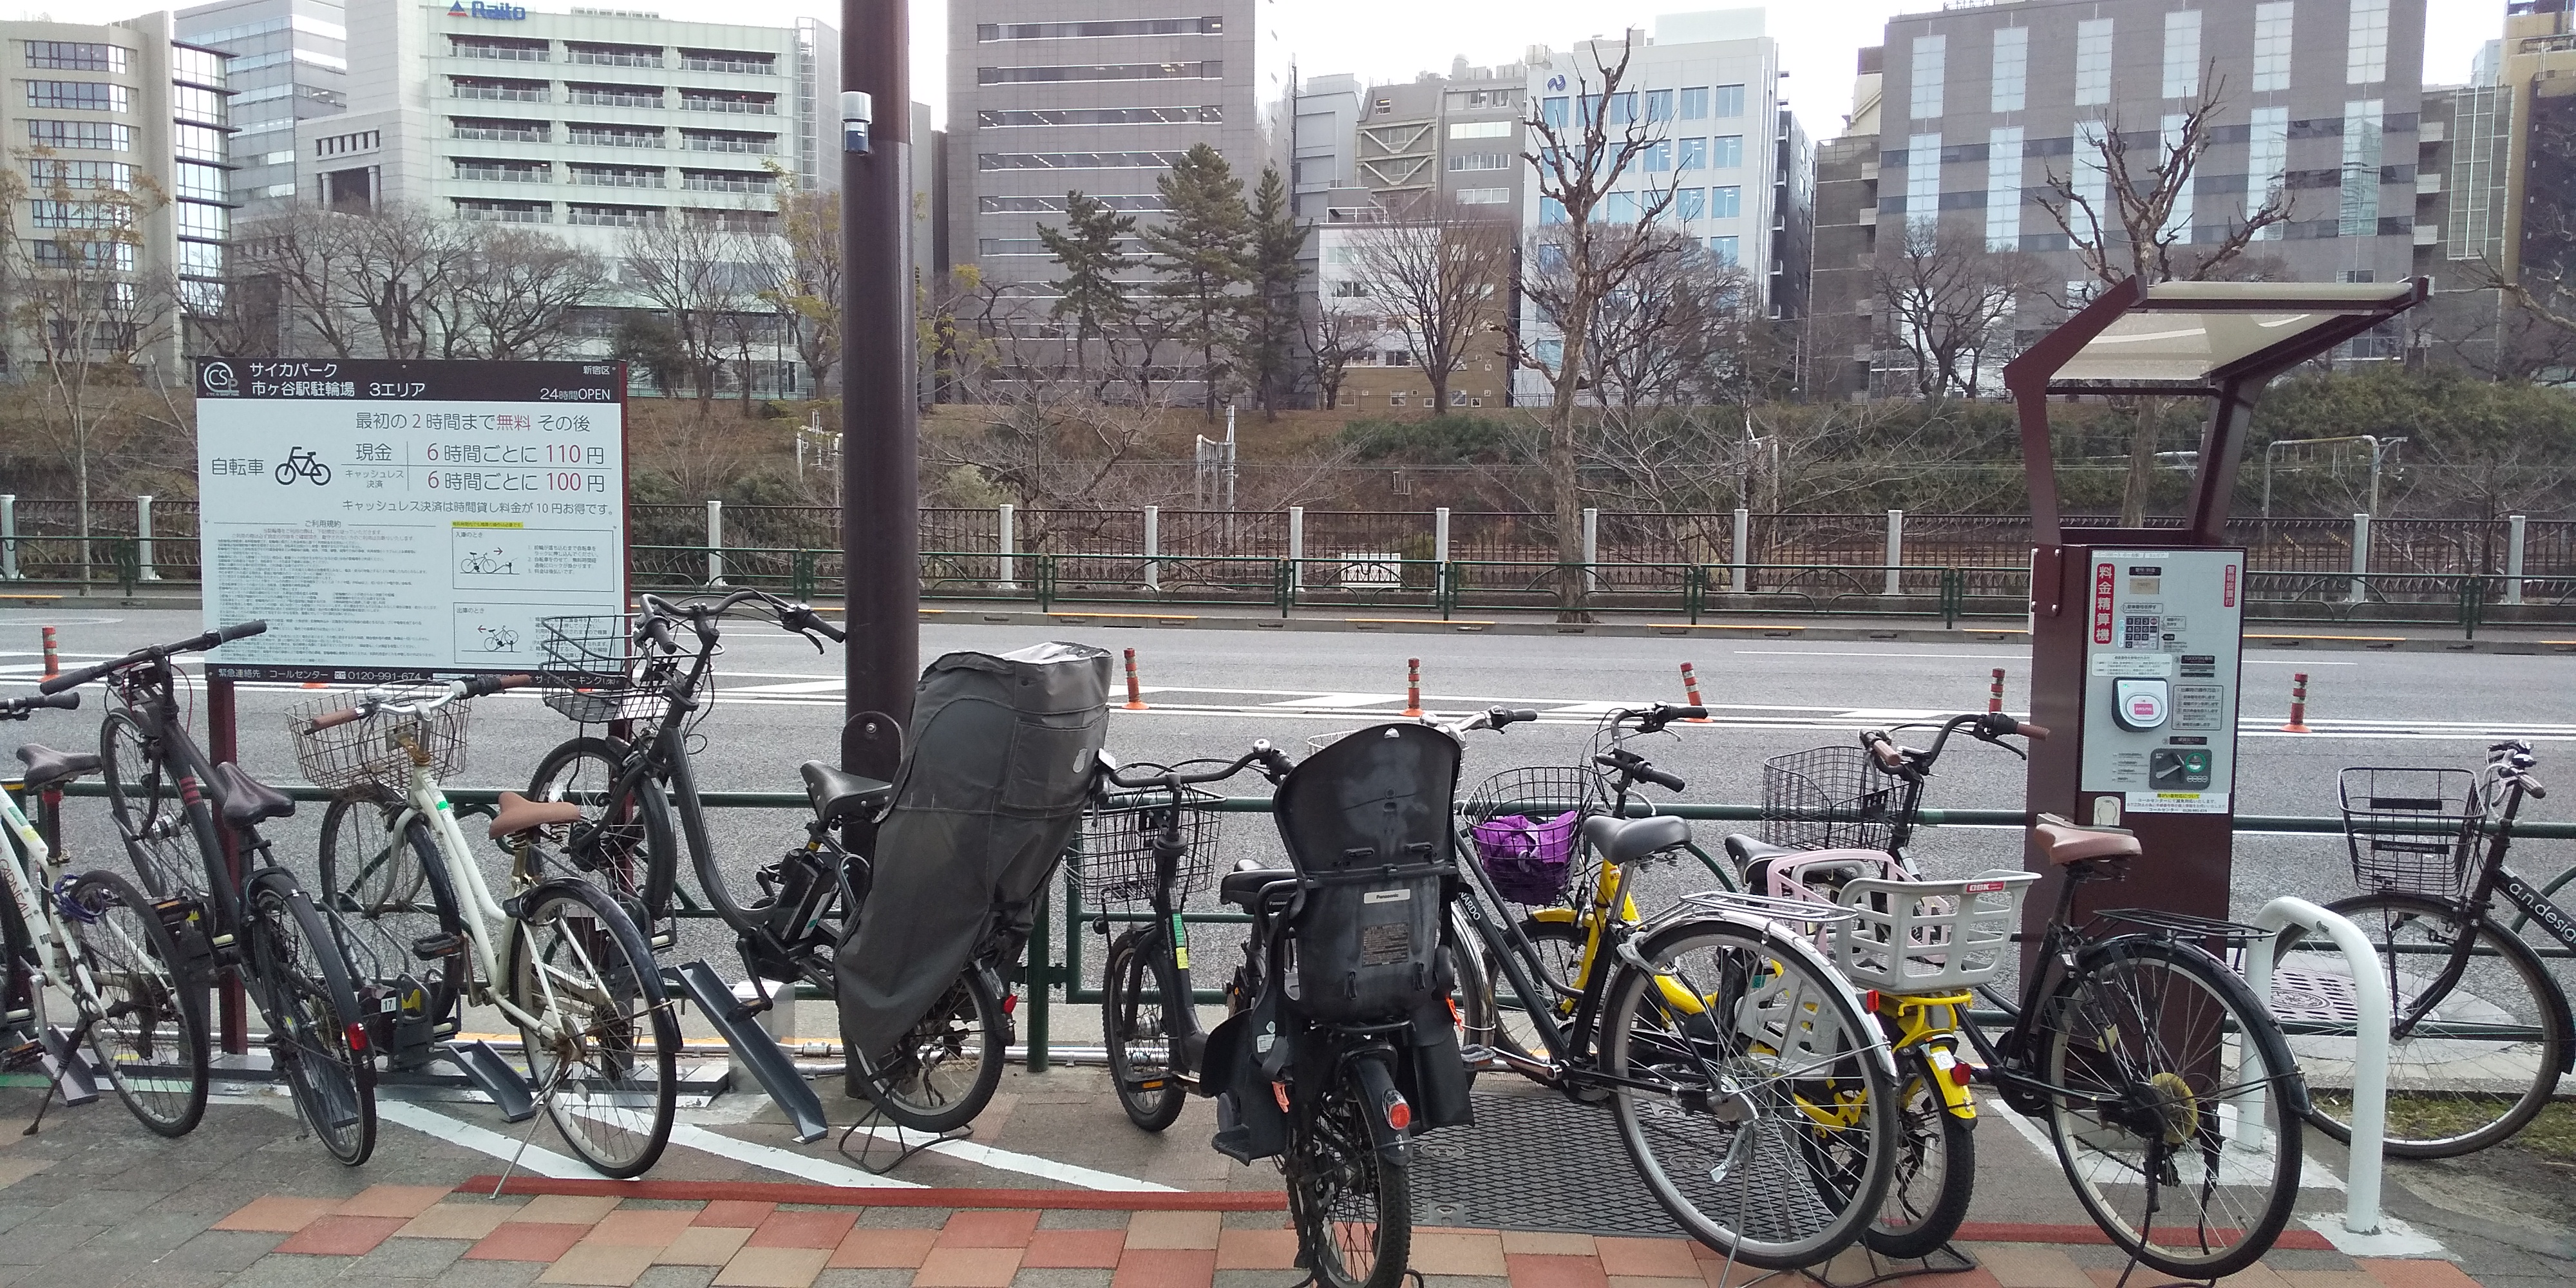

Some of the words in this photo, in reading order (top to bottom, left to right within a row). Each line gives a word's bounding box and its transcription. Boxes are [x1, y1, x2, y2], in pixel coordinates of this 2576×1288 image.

[471, 1, 526, 20] Raito
[250, 363, 337, 377] サイカパーク
[583, 365, 610, 375] 新宿区
[252, 381, 355, 397] 市ヶ谷駅駐輪場
[369, 383, 426, 397] 3エリア
[355, 442, 392, 461] 現金
[211, 457, 264, 476] 自転車
[345, 469, 404, 478] キャッシュレス
[366, 480, 383, 489] 決済
[2096, 565, 2113, 641] 料金精算機
[218, 668, 261, 678] 緊急連絡先
[269, 670, 328, 679] コールセンター
[348, 671, 421, 681] 0120-991-674
[2509, 883, 2576, 943] a.n.desig
[384, 999, 393, 1010] 17
